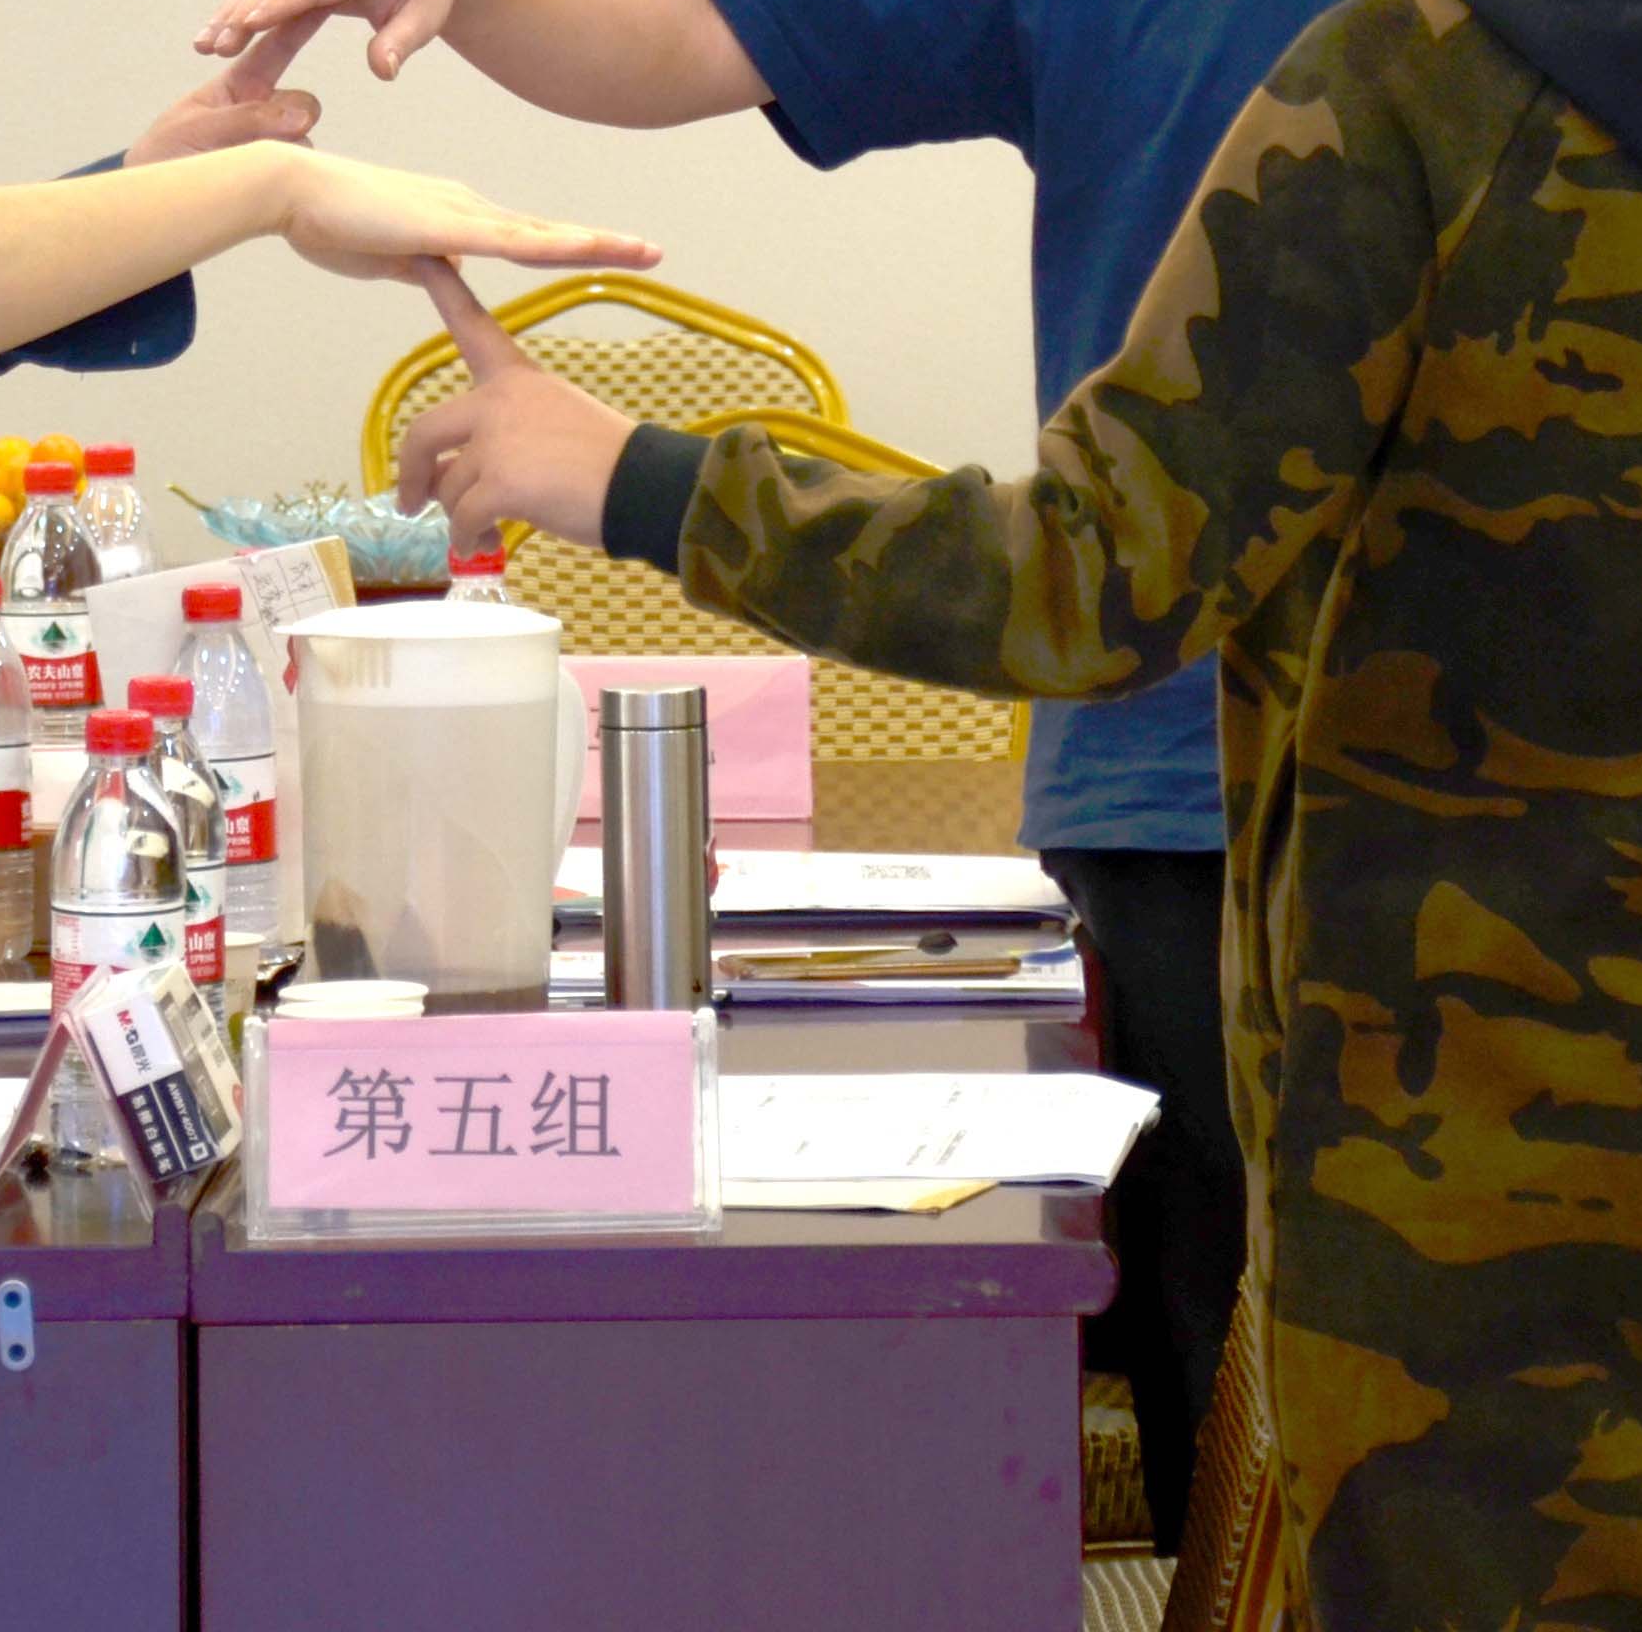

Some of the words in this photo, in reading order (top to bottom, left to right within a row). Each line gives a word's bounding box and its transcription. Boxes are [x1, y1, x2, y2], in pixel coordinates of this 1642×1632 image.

[26, 663, 84, 681] 农夫山泉
[224, 816, 250, 835] 山泉
[188, 931, 216, 952] 山泉
[323, 1067, 621, 1160] 第五组
